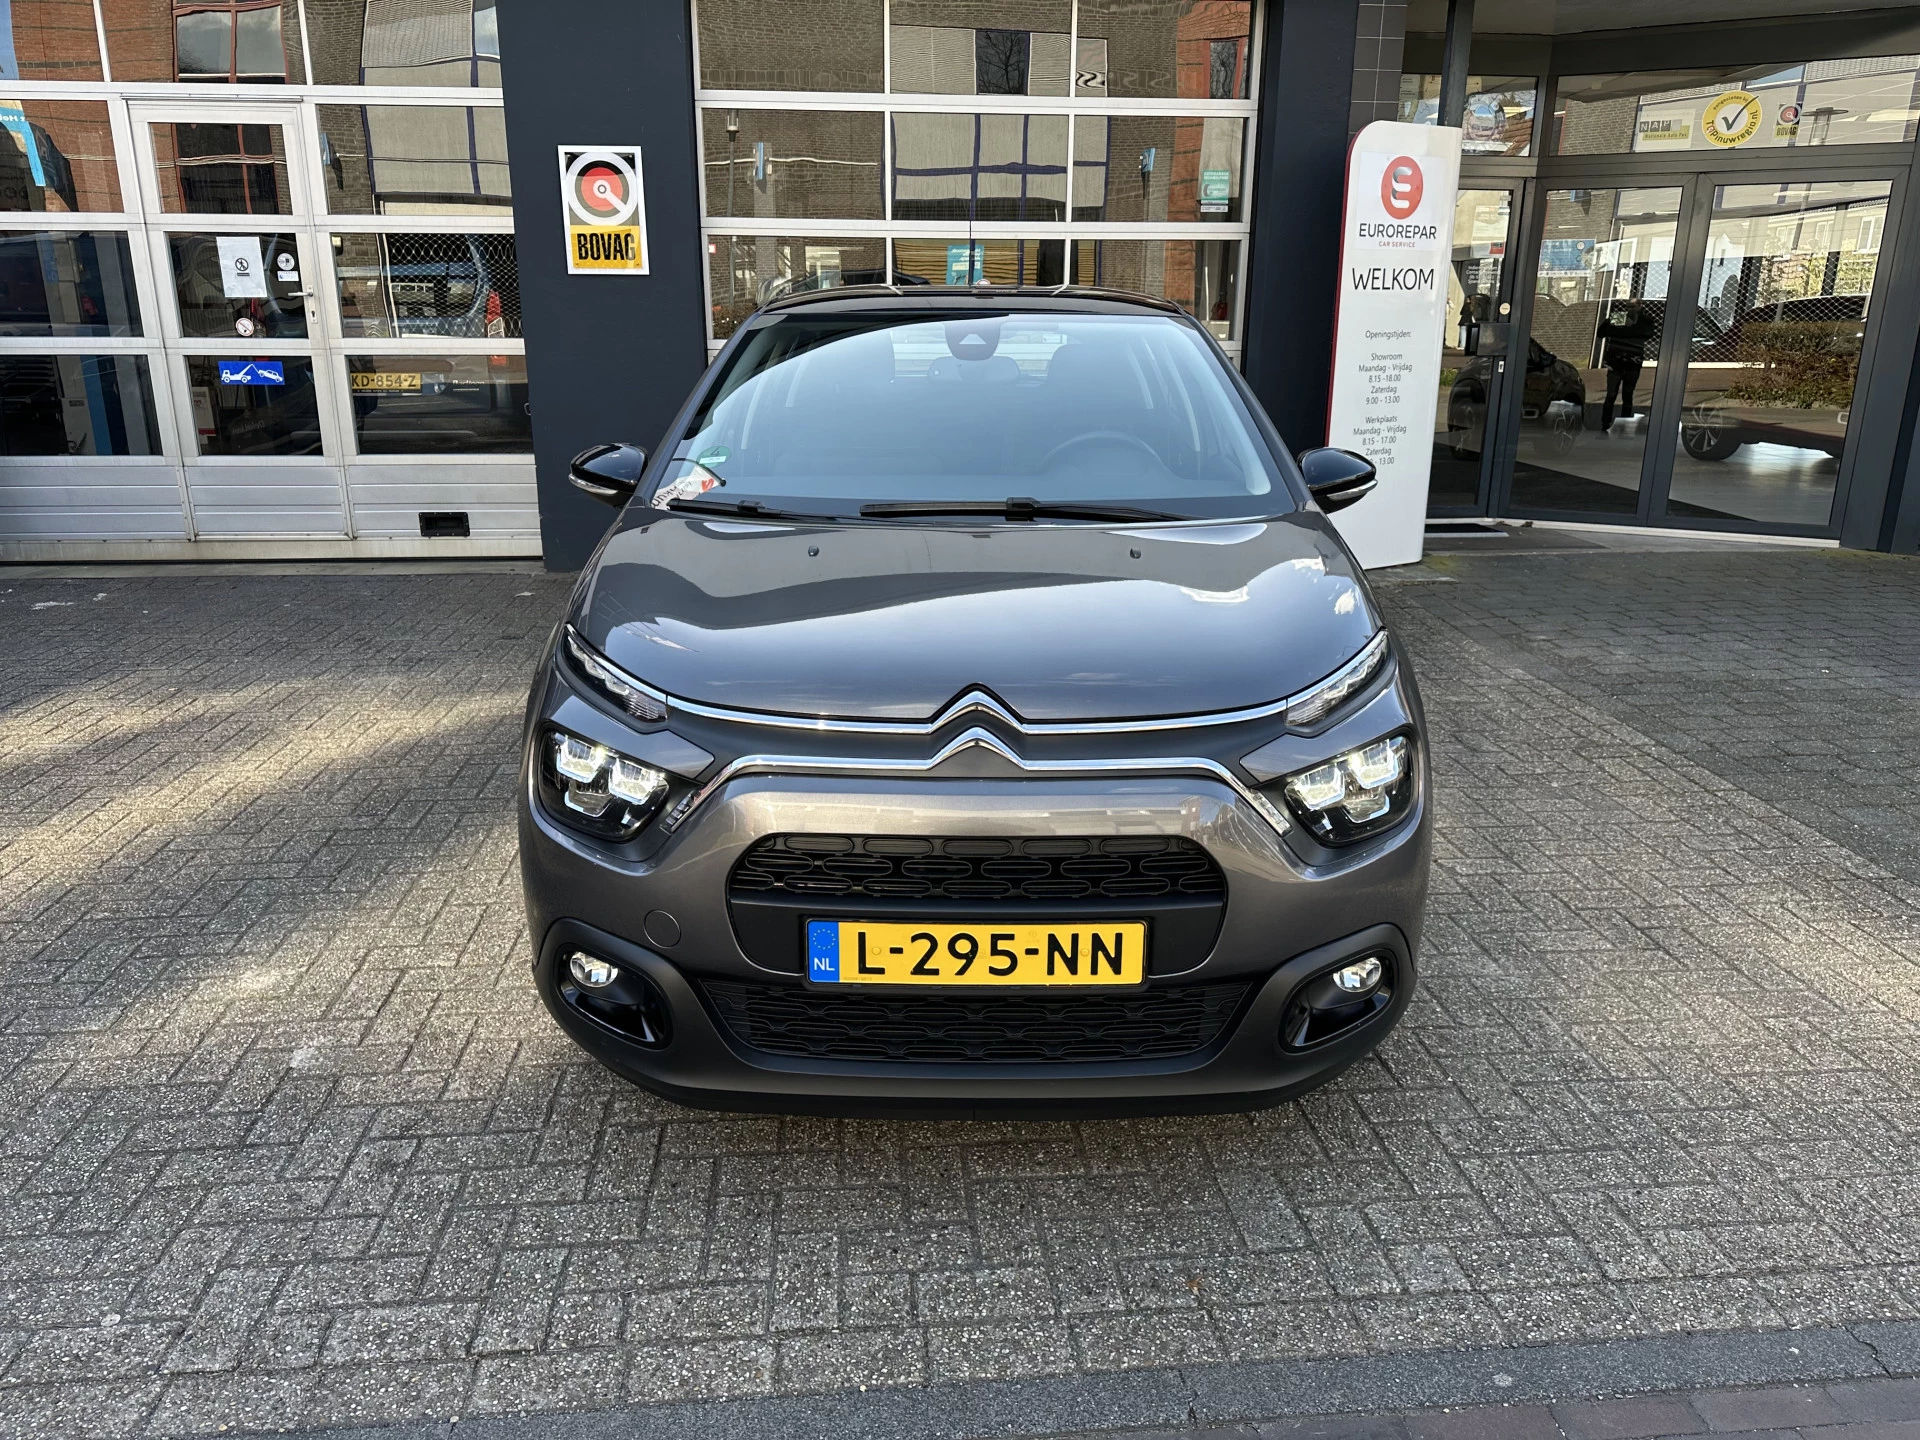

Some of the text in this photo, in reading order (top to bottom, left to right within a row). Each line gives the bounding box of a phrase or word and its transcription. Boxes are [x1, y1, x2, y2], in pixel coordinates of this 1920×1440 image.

[1641, 120, 1670, 130] NAP
[1777, 127, 1797, 136] BOVAG
[1359, 223, 1437, 239] EUROREPAR
[577, 233, 636, 260] BOVAG
[1352, 267, 1434, 290] WELKOM
[1365, 329, 1411, 340] Openingstijden:
[1371, 353, 1402, 361] Showroom
[1358, 364, 1386, 373] Maandag
[1392, 363, 1412, 373] Vrijdag
[351, 374, 416, 387] KD-854-Z
[1369, 375, 1381, 383] 8.15
[1371, 385, 1397, 394] Zaterdag
[1366, 396, 1378, 405] 9.00
[1384, 395, 1400, 404] 13.00
[1365, 415, 1397, 425] Werkplaats
[1353, 427, 1380, 436] Maandag
[1387, 425, 1407, 435] Vrijdag
[1362, 437, 1375, 446] 8.15
[1381, 436, 1397, 444] 17.00
[1365, 447, 1391, 456] Zaterdag
[1379, 457, 1394, 465] 13.00
[814, 931, 1123, 977] NL L-295-NN
